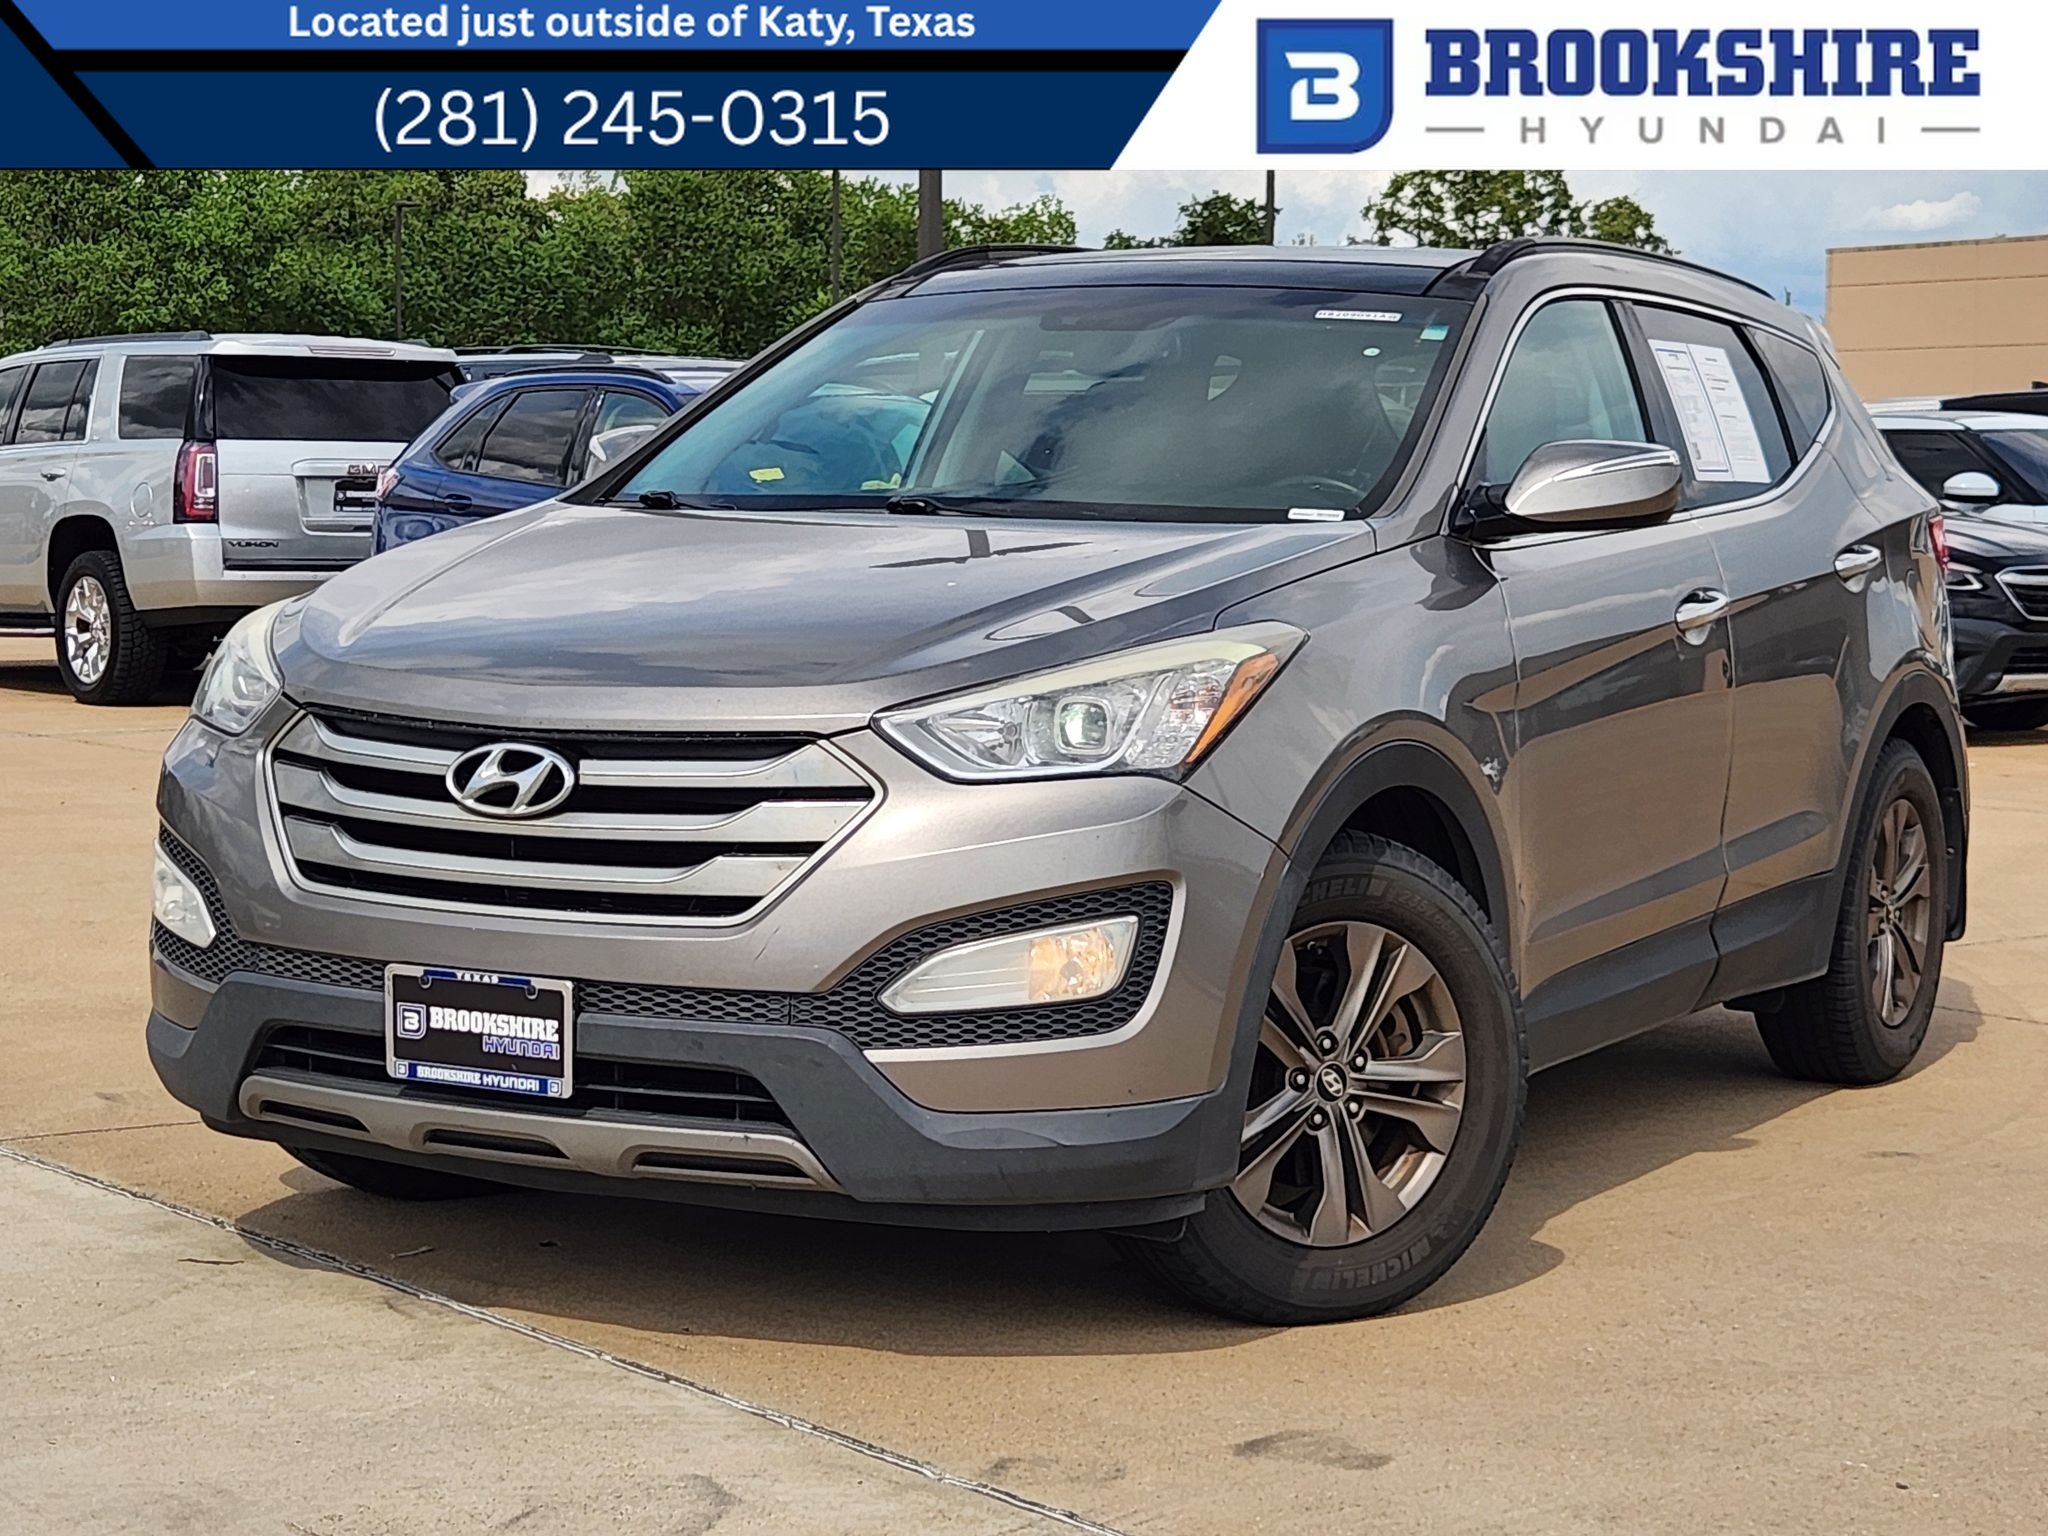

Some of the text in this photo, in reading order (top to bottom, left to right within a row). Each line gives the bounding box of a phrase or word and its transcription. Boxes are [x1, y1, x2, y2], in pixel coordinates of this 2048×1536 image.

[227, 540, 280, 549] YUKON
[429, 1005, 560, 1042] BROOKSHIRE
[482, 1035, 561, 1061] HYUNDAI
[416, 1065, 481, 1085] BROOKSHIRE
[482, 1074, 540, 1092] HYUNDAI
[1310, 1236, 1432, 1291] MICHELIN
